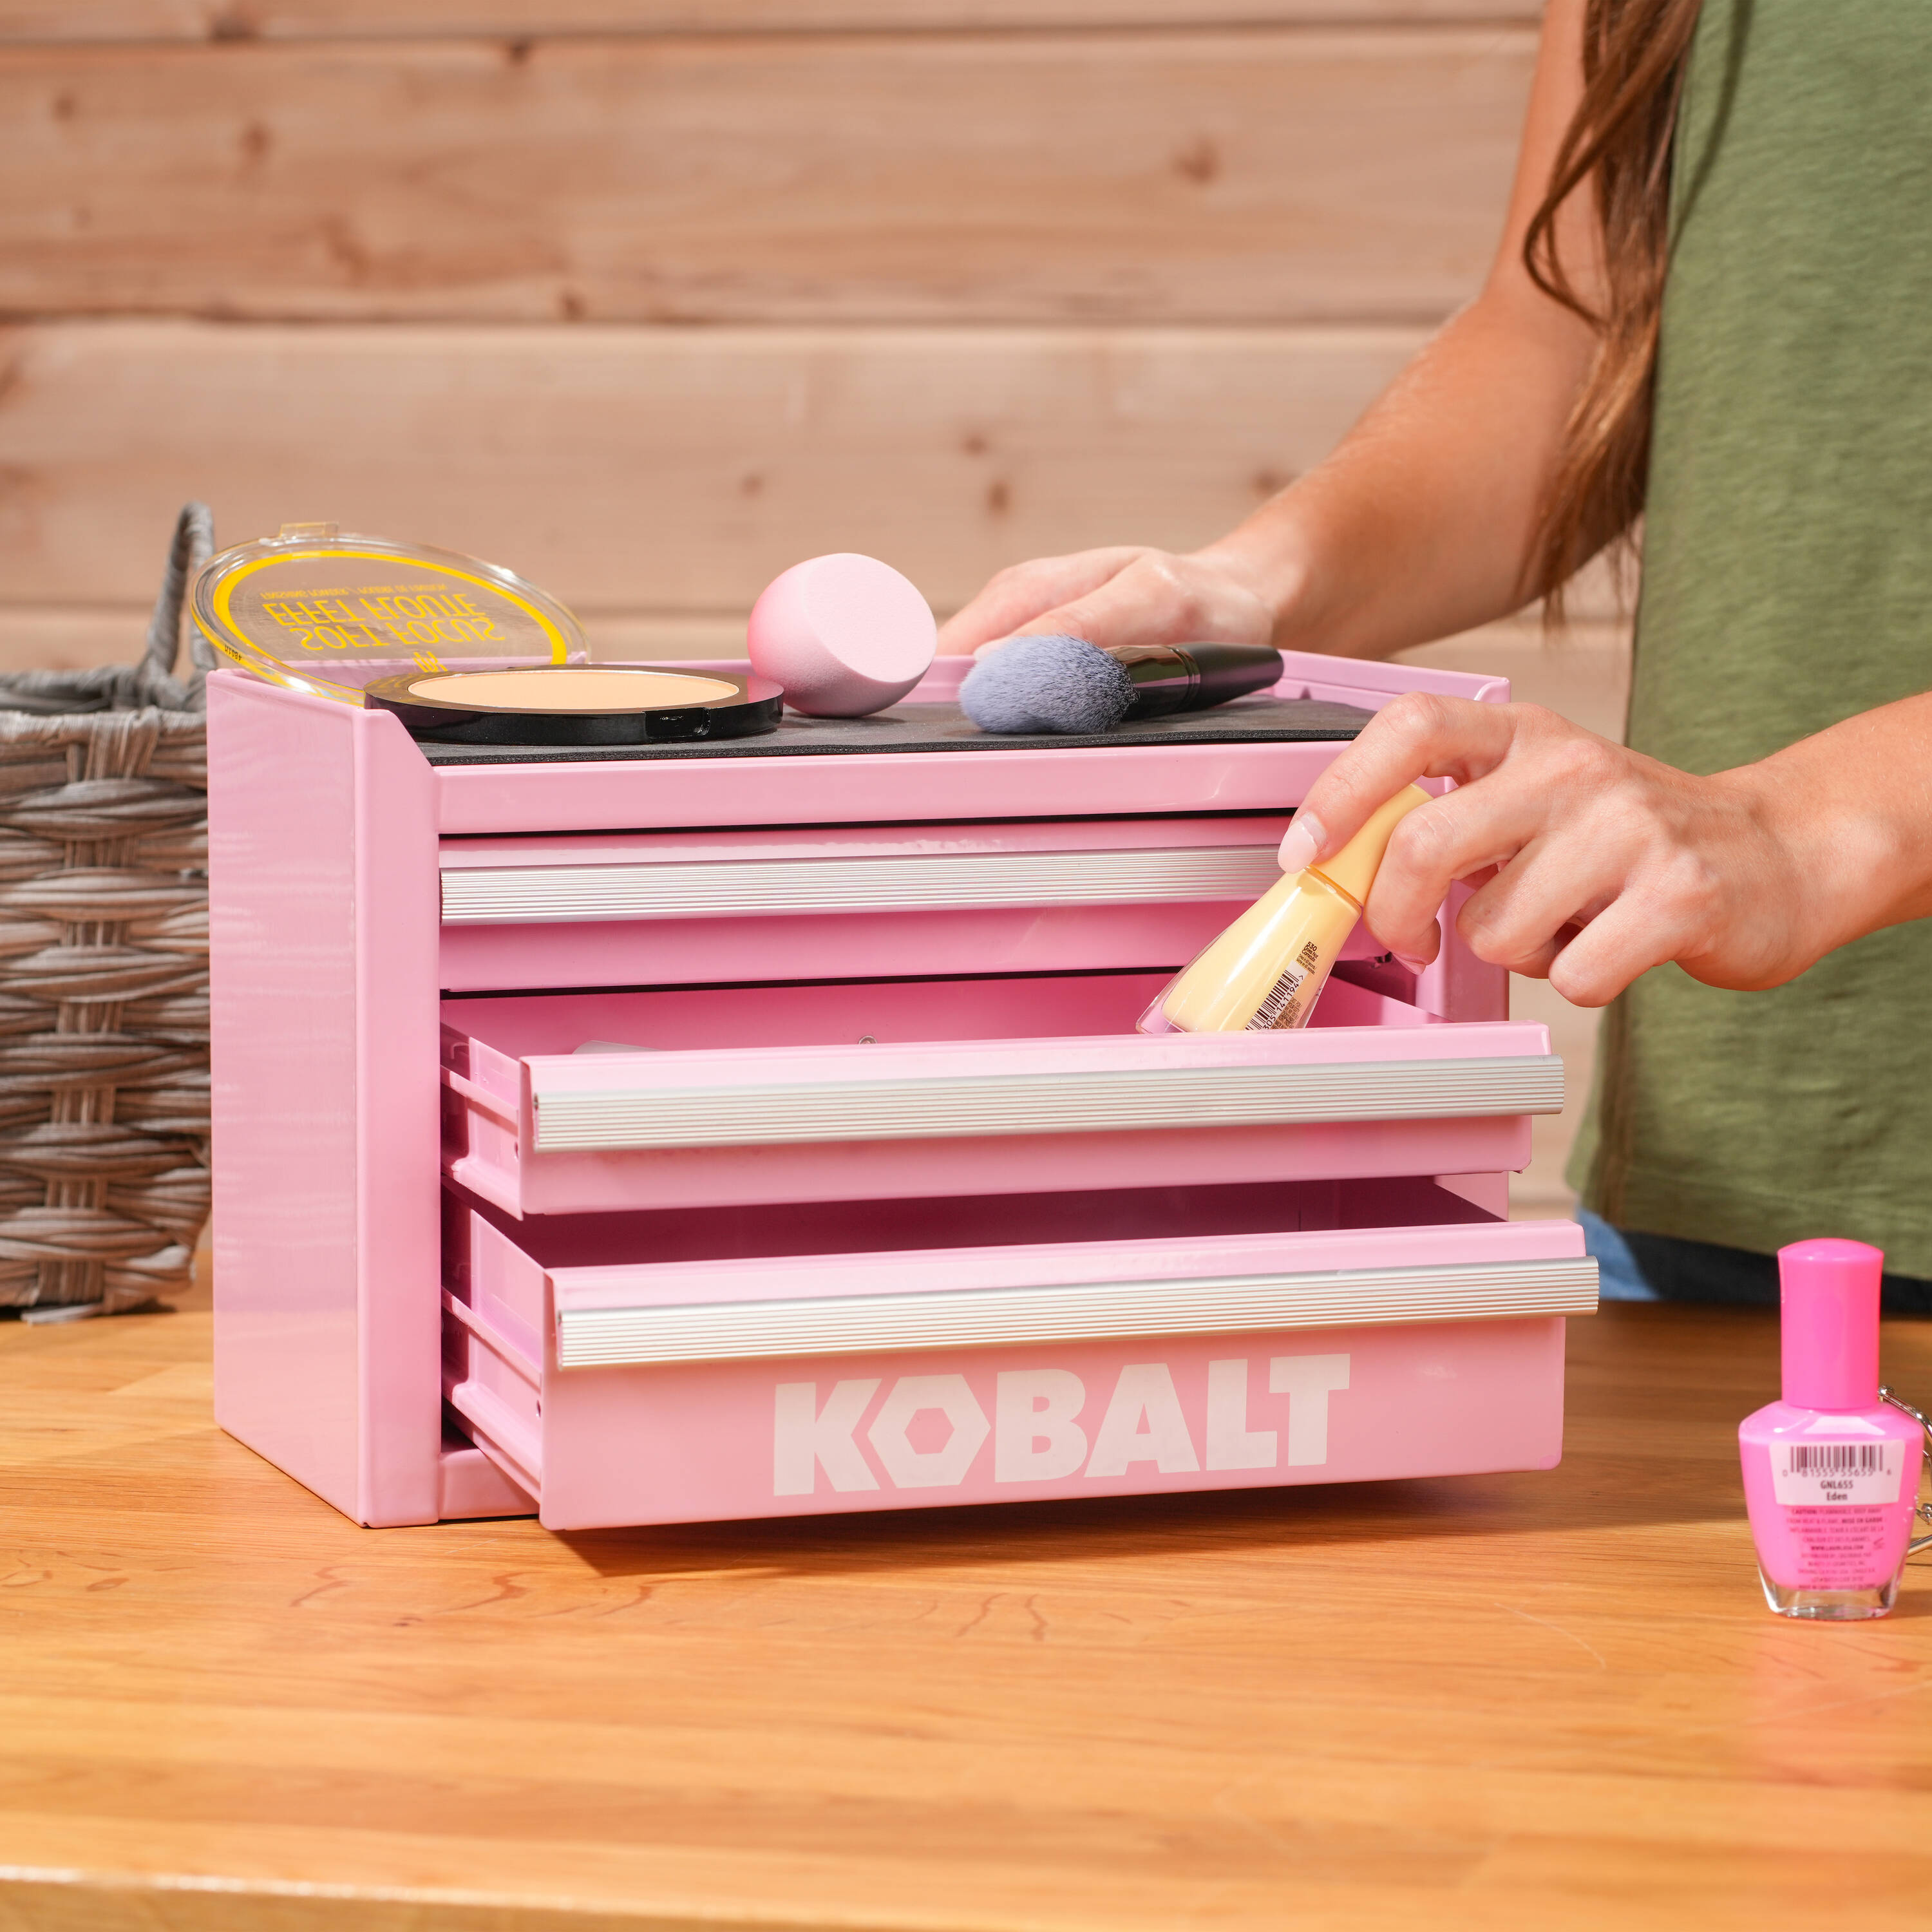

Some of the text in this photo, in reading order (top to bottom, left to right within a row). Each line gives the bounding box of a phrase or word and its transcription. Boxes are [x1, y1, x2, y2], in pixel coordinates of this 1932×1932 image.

[1307, 941, 1318, 951] 530
[1276, 983, 1299, 1011] 141194
[773, 1353, 1350, 1496] KOBALT
[1821, 1480, 1853, 1489] GNL655
[1826, 1492, 1848, 1501] Eden
